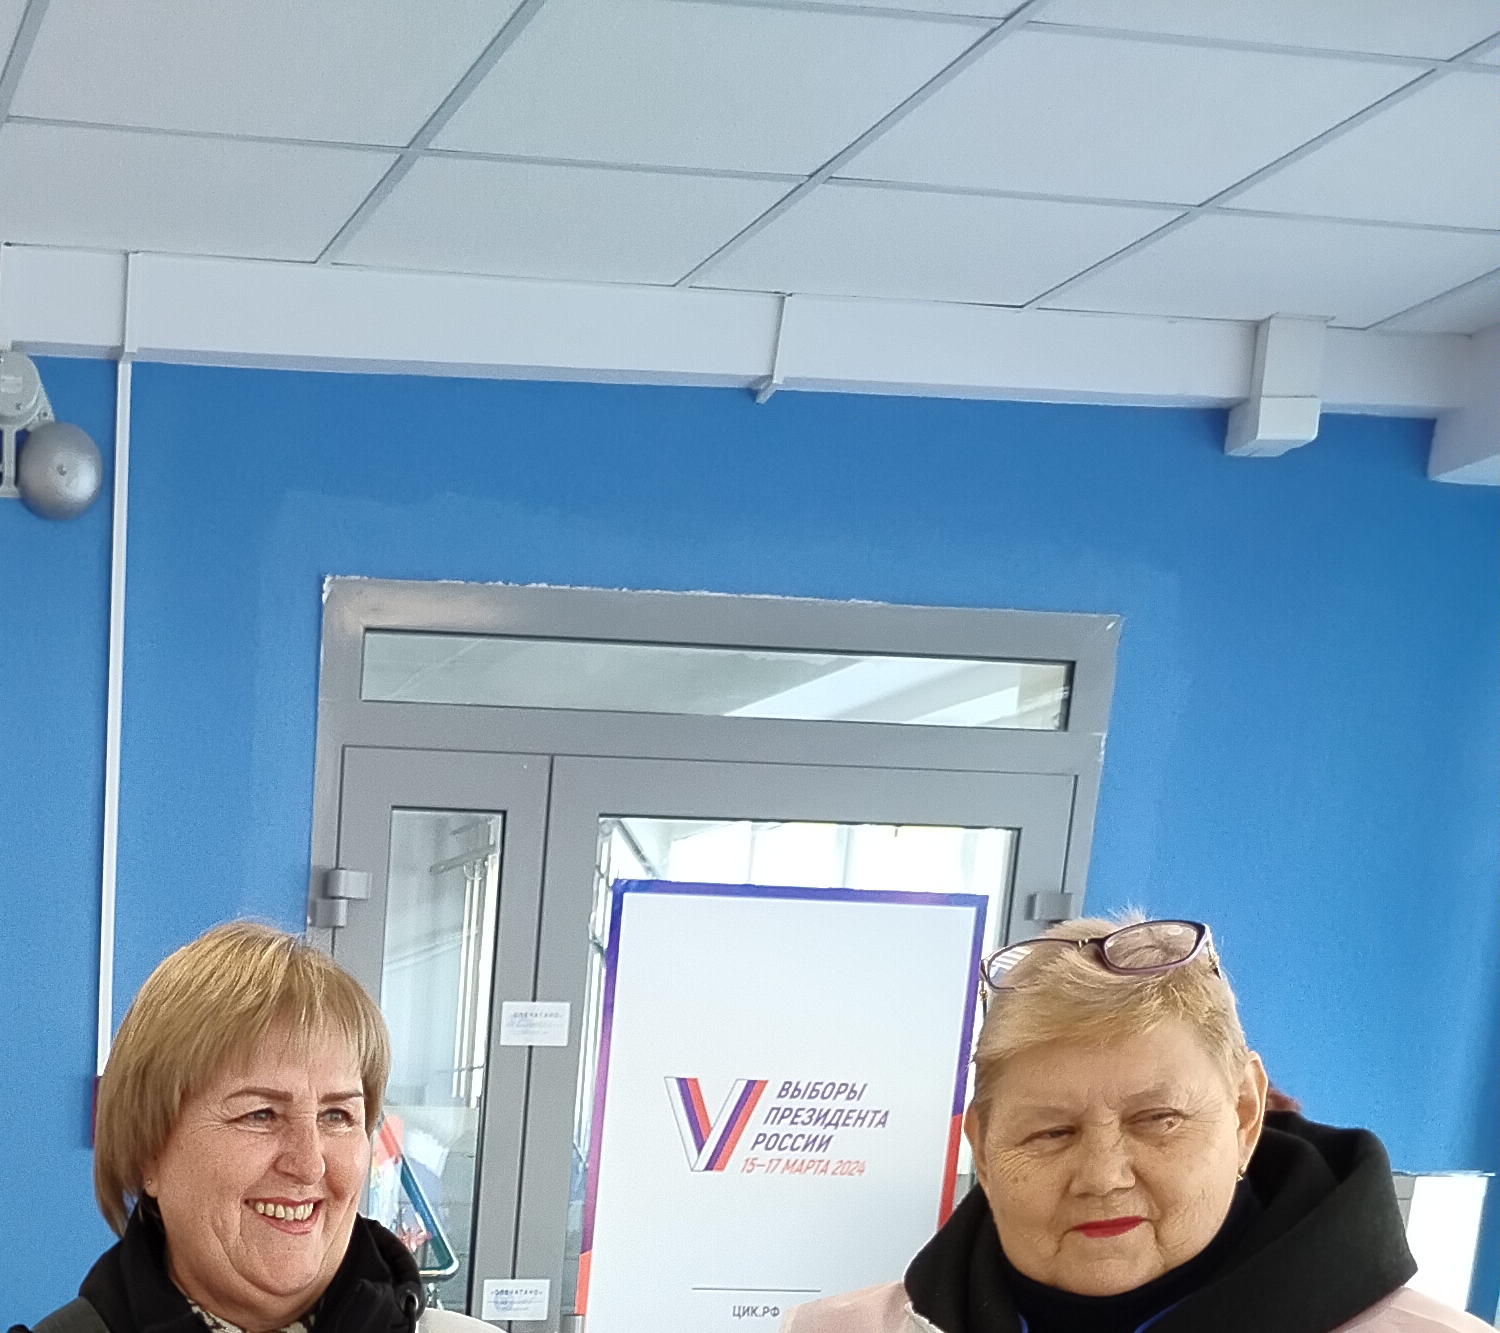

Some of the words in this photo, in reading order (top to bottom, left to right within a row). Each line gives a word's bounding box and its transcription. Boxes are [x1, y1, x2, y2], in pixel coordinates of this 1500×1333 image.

[777, 1080, 869, 1101] ВЫБОРЫ
[763, 1107, 890, 1130] ПРЕЗИДЕНТА
[750, 1132, 834, 1153] РОССИИ
[782, 1158, 829, 1175] МАРТА
[831, 1159, 867, 1177] 2024
